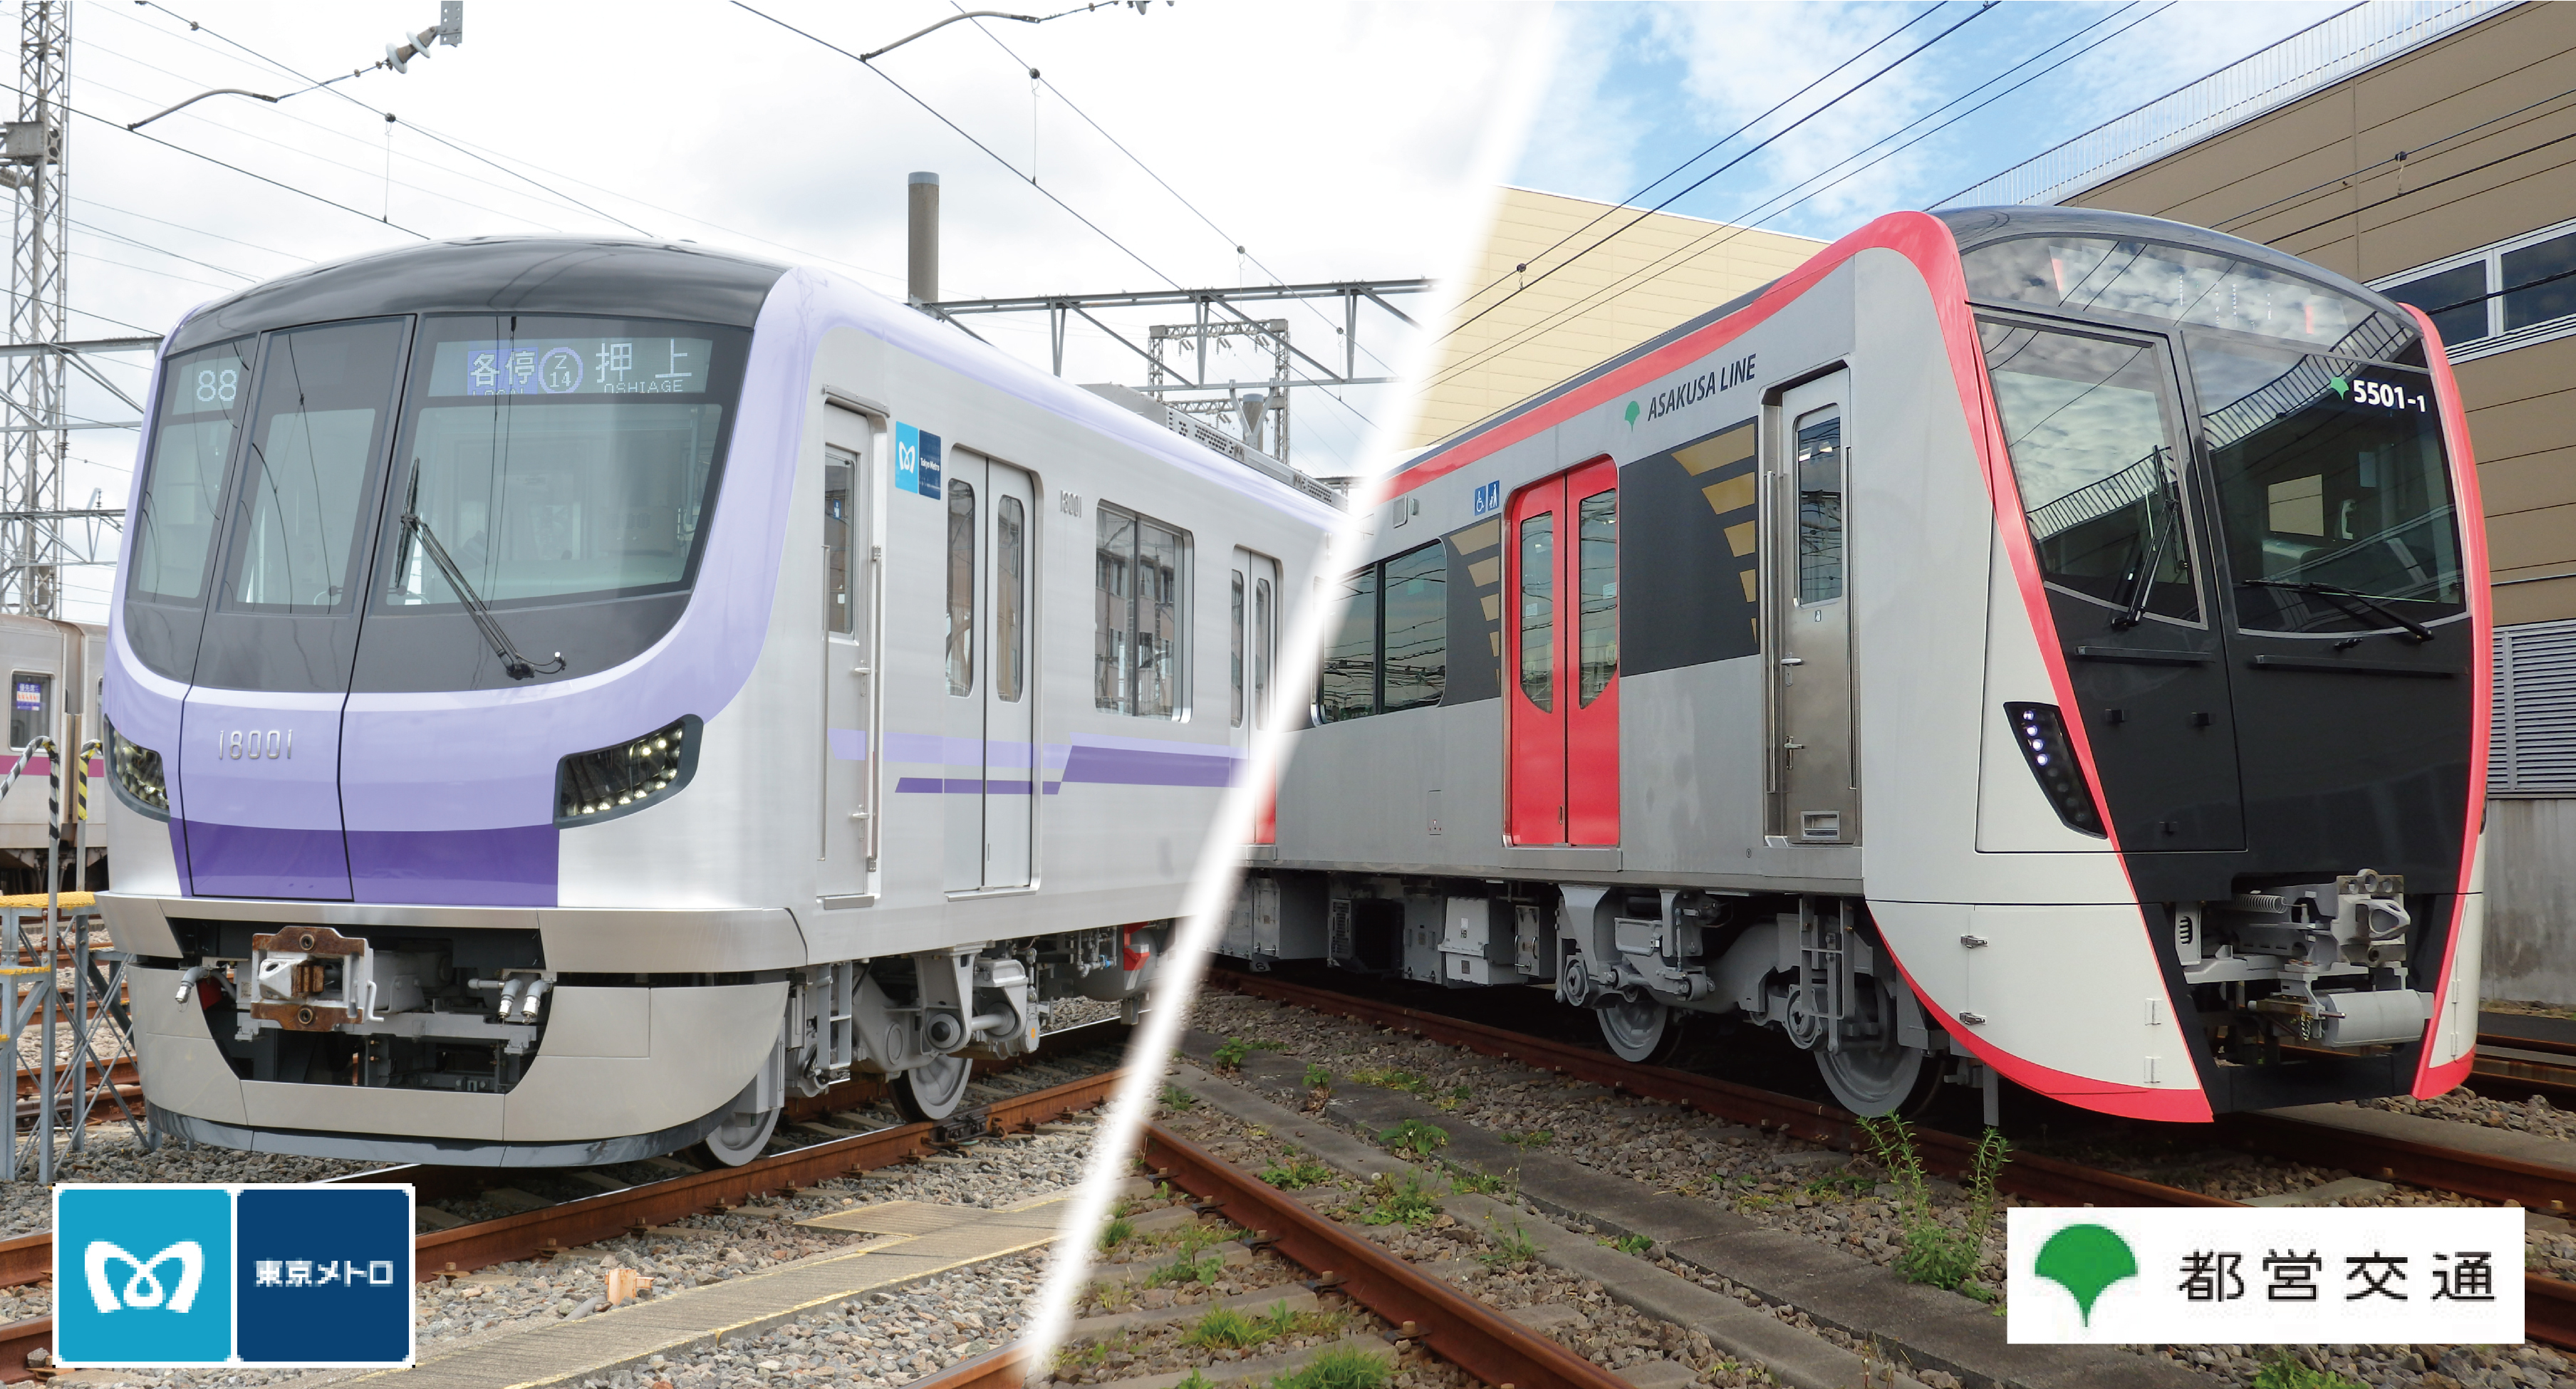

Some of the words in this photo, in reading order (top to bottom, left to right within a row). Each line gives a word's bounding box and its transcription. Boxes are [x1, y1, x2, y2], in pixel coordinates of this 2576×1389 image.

[470, 353, 534, 387] 各停
[555, 355, 566, 369] Z
[596, 338, 692, 383] 押上
[197, 369, 237, 401] 88
[550, 371, 571, 387] 14
[1647, 371, 1715, 422] ASAKUSA
[1720, 353, 1756, 392] LINE
[2353, 380, 2426, 412] 5501-1
[920, 457, 930, 469] Tokyo
[930, 461, 940, 472] Metro
[219, 729, 293, 760] 18001
